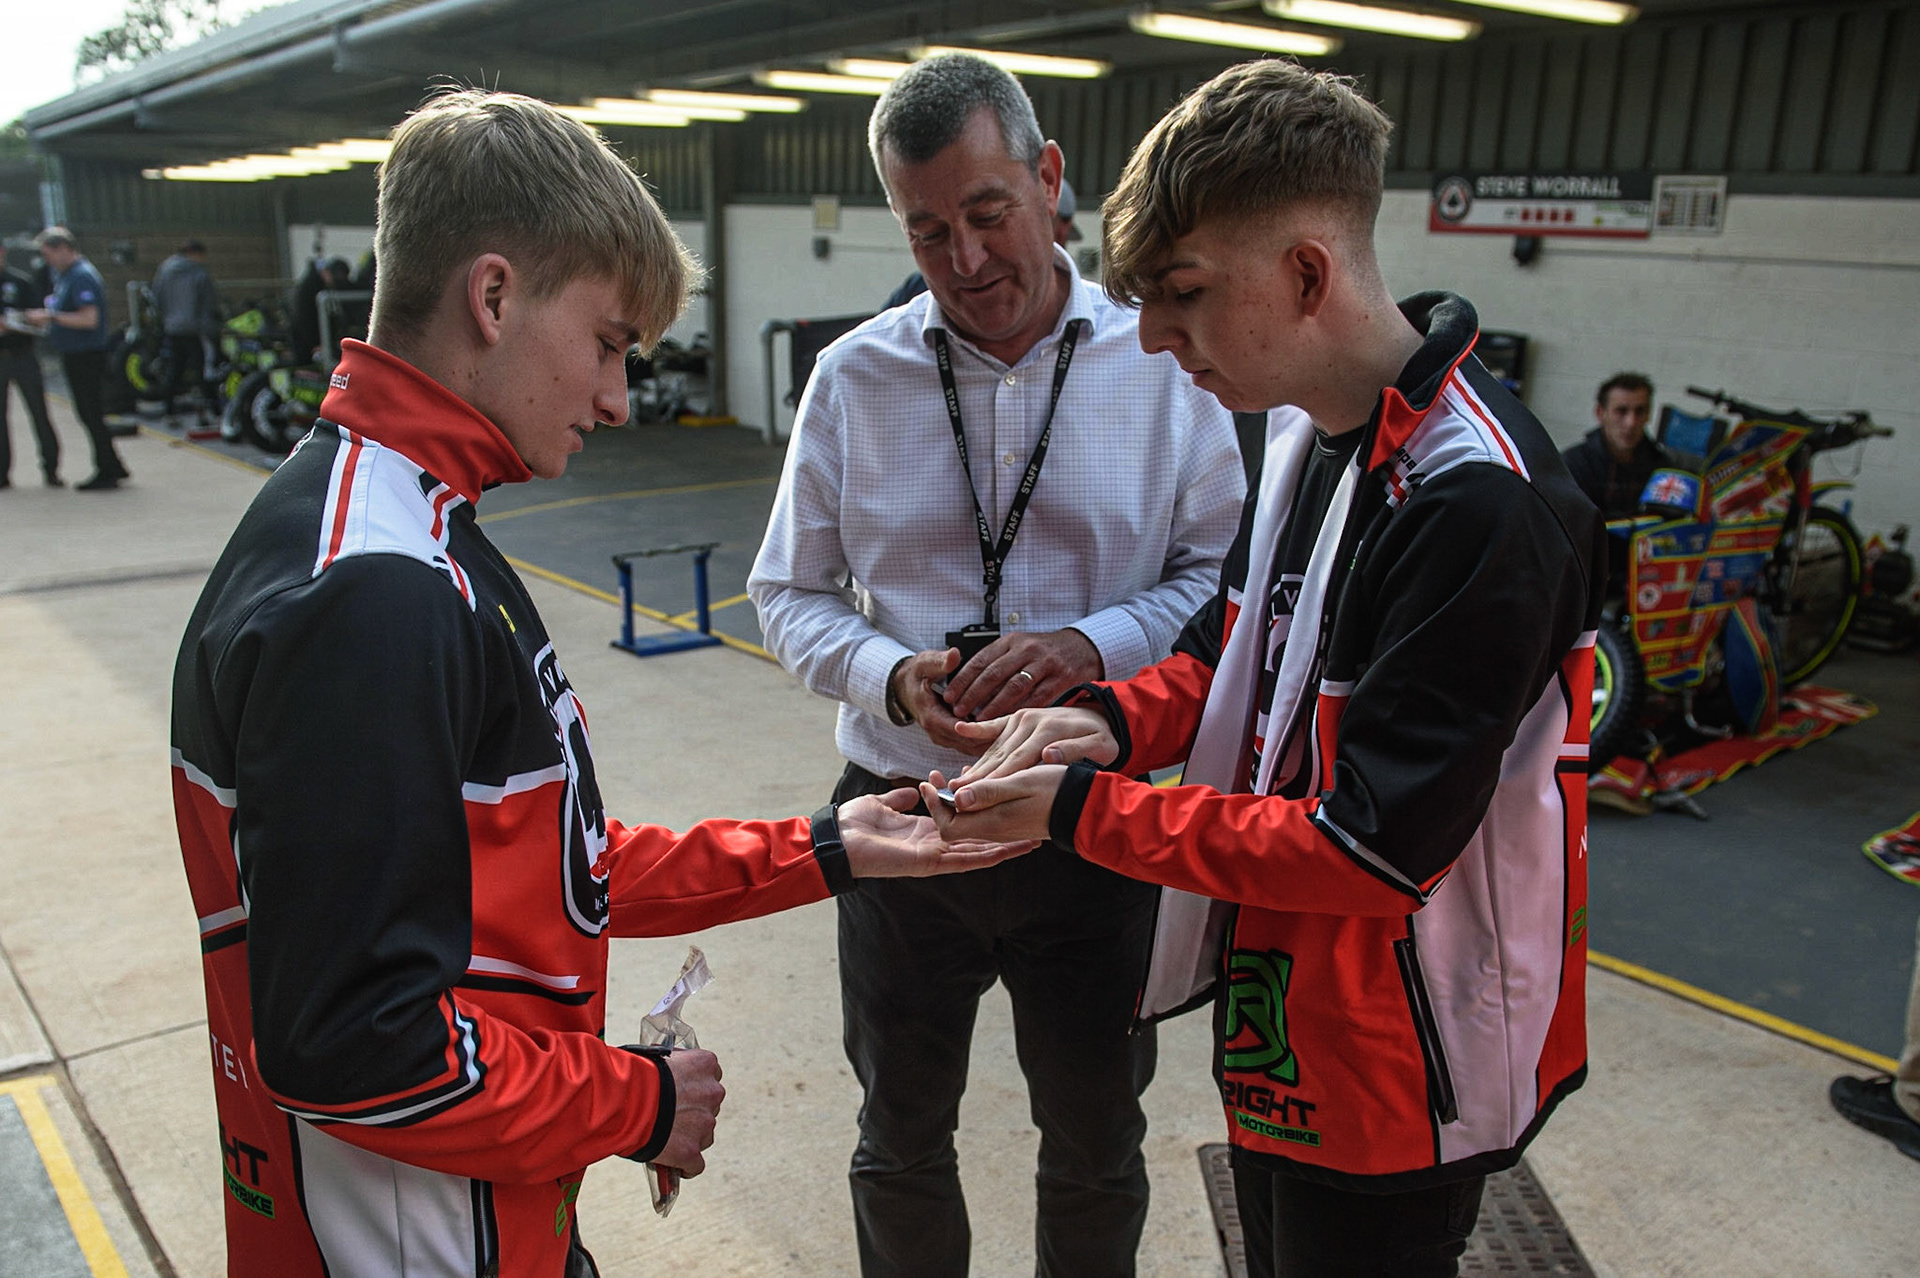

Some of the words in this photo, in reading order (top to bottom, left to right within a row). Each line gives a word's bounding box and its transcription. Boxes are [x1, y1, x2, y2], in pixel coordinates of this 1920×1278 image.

[1476, 175, 1528, 197] STEVE
[1531, 176, 1622, 198] WORRALL
[937, 343, 950, 371] STAFF
[1057, 342, 1073, 370] STAFF
[945, 387, 959, 418] STAFF
[1040, 421, 1053, 448] STA
[1021, 462, 1039, 495] STAFF
[977, 511, 991, 543] STAFF
[1003, 509, 1022, 541] STAFF
[1238, 1113, 1321, 1146] MOTORBIKE
